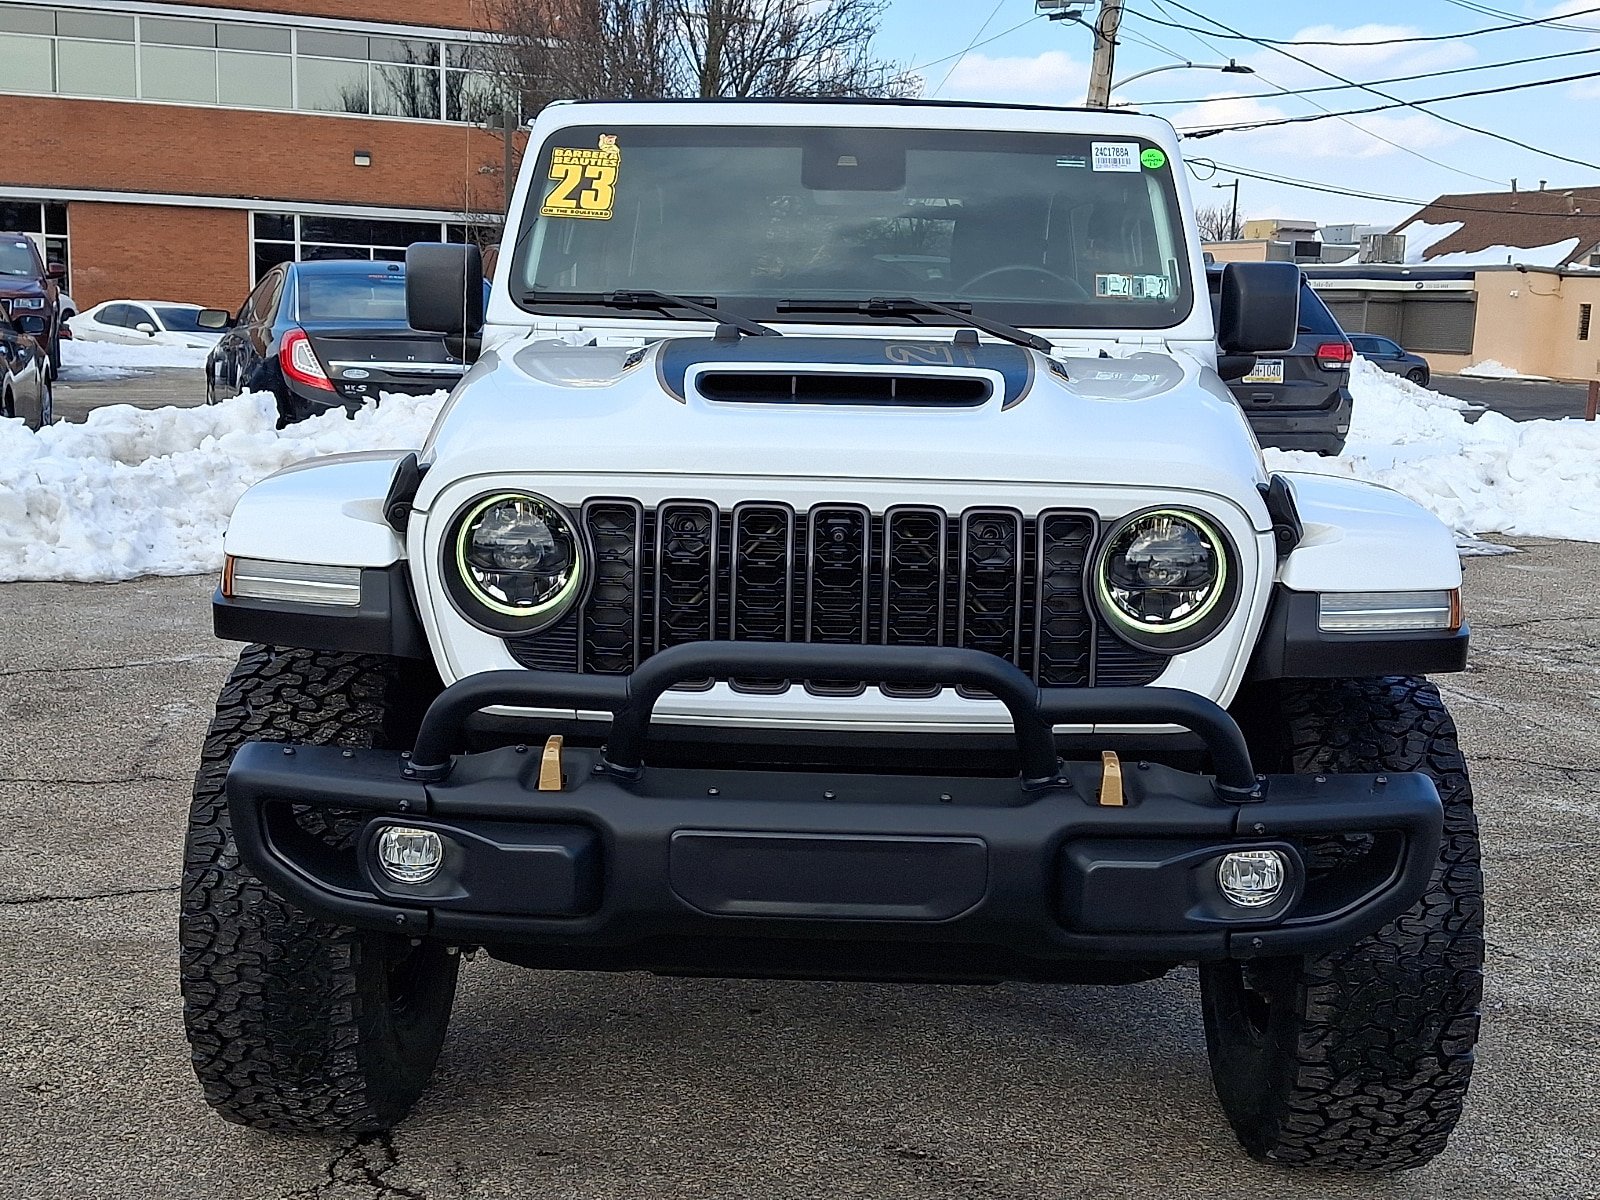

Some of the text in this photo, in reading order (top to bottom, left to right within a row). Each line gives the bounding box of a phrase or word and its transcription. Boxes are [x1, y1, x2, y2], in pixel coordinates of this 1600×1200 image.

[554, 149, 618, 160] BARBERA
[1095, 147, 1129, 157] 24C1788A
[553, 157, 618, 167] BEAUTIES
[546, 164, 616, 210] 23
